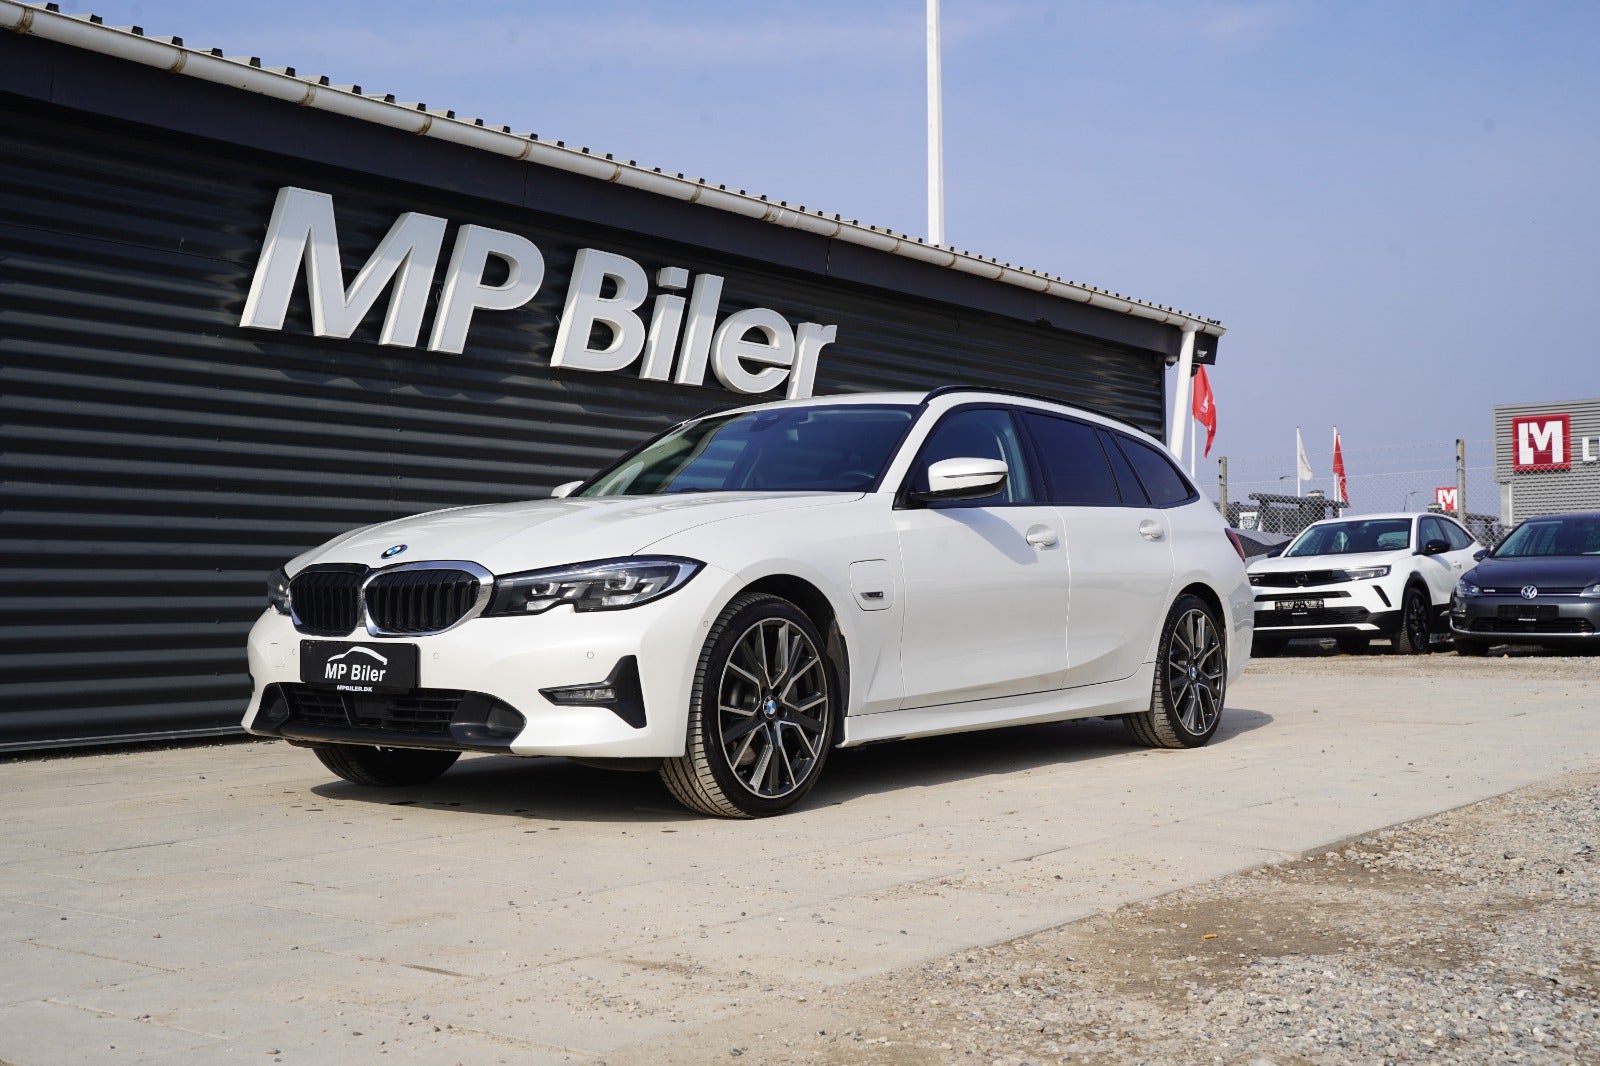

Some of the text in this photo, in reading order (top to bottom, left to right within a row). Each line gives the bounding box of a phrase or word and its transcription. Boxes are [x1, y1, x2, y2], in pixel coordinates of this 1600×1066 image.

[239, 186, 836, 400] MP Biler
[325, 663, 386, 681] MP Biler
